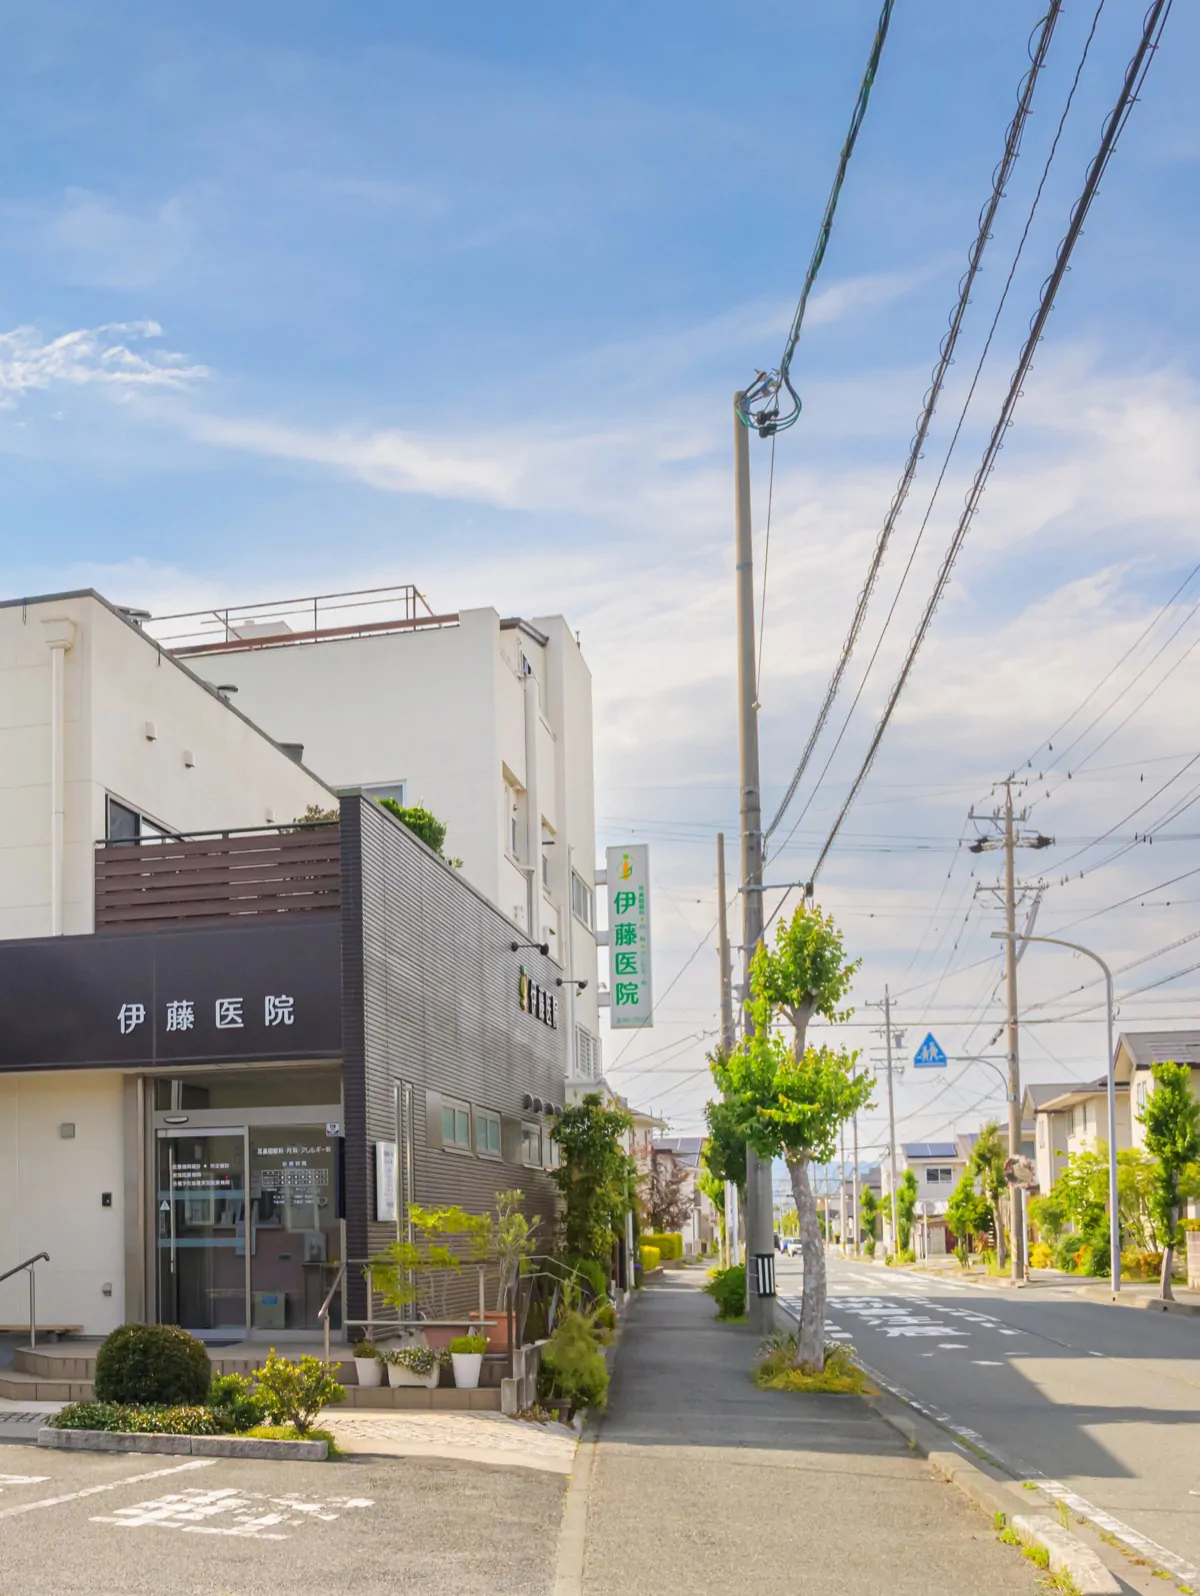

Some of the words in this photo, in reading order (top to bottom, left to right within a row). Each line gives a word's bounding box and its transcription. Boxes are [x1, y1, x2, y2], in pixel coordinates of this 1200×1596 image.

[613, 890, 639, 1006] 伊藤医院
[116, 994, 295, 1034] 伊藤医院
